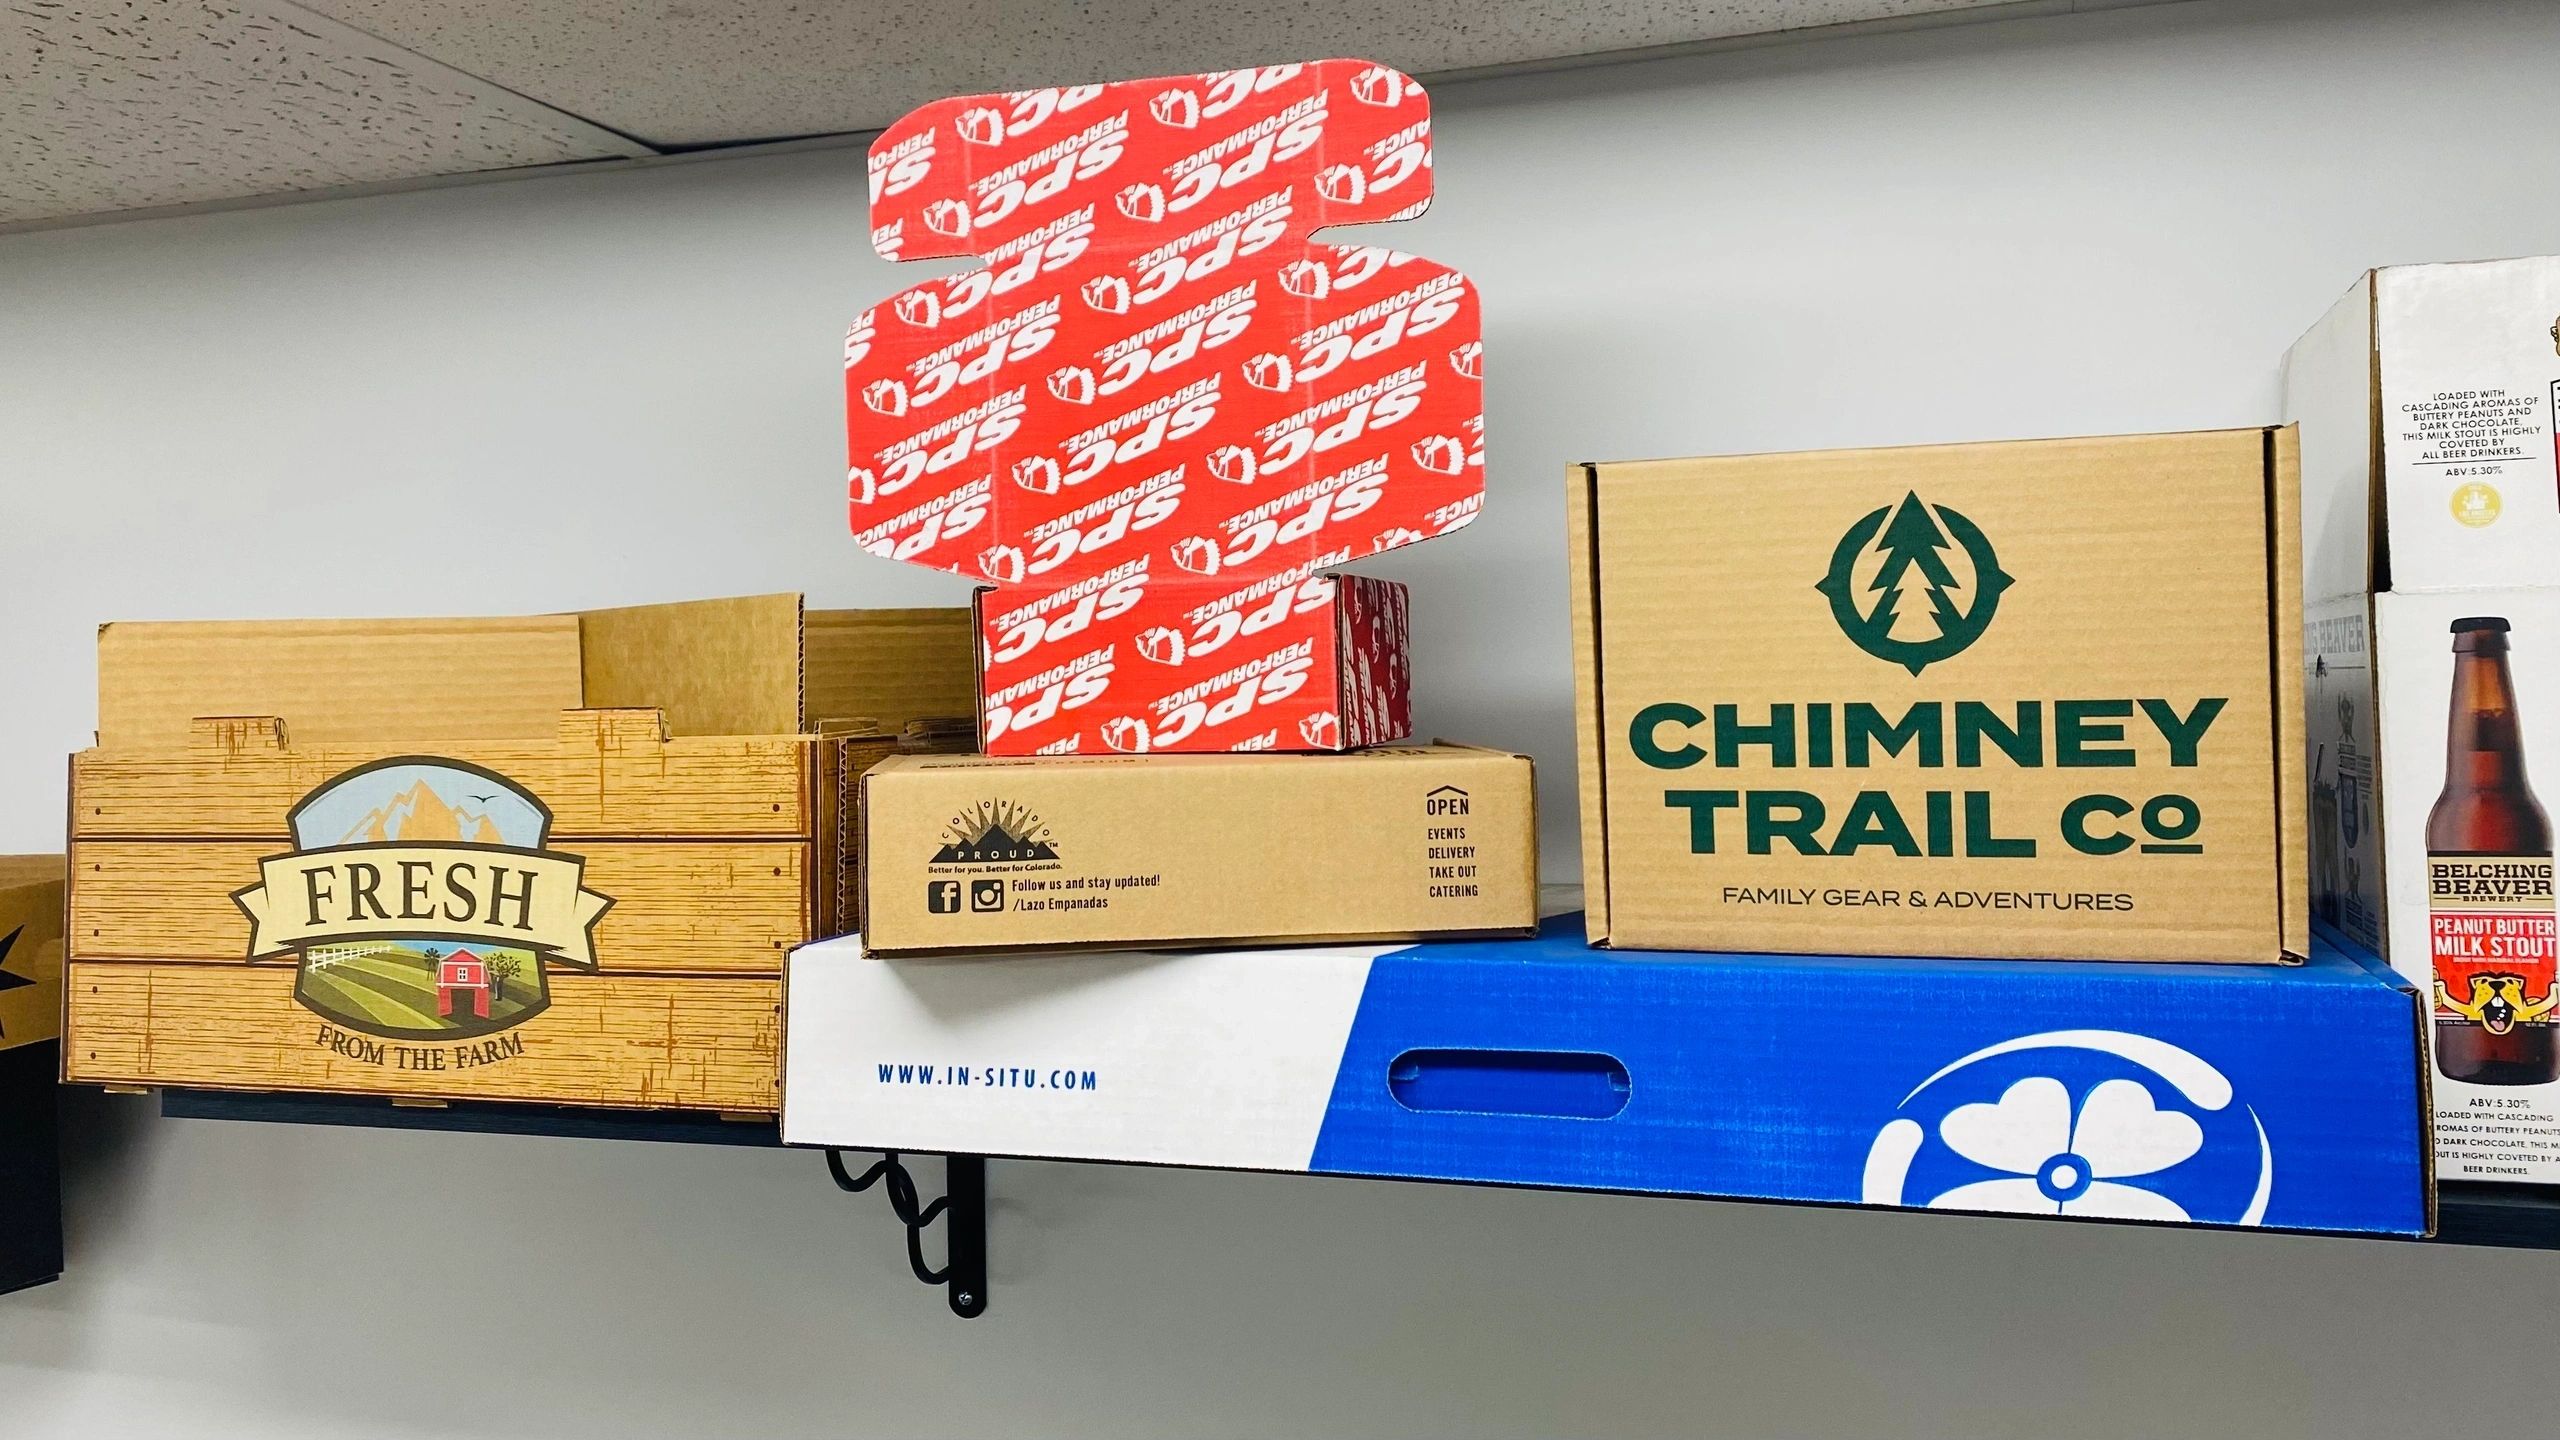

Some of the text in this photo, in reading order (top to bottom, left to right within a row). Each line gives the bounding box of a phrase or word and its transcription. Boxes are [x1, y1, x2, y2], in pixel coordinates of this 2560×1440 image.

[975, 110, 1129, 196] PERFORMANCE
[1168, 110, 1329, 212] SPC
[1171, 89, 1329, 180] PERFORMANCE
[974, 129, 1130, 228] SPC
[1133, 206, 1293, 304] SPC
[1136, 185, 1293, 273] PERFORMANCE
[942, 223, 1095, 319] SPC
[913, 295, 1060, 376] PERFORMANCE
[1102, 279, 1257, 362] PERFORMANCE
[1295, 286, 1465, 382] SPC
[1299, 272, 1464, 350] PERFORMANCE
[910, 314, 1060, 407] SPC
[1098, 300, 1257, 395] SPC
[880, 384, 1026, 464] PERFORMANCE
[1067, 372, 1221, 453] PERFORMANCE
[1259, 381, 1427, 475] SPC
[1263, 360, 1426, 443] PERFORMANCE
[2402, 397, 2539, 412] CASCADING AROMAS OF
[2413, 407, 2532, 421] BUTTERY PEANUTS AND
[2420, 421, 2449, 431] DARK
[2433, 389, 2505, 401] LOADED WITH
[878, 404, 1026, 495] SPC
[1063, 392, 1221, 485] SPC
[2402, 426, 2541, 441] THIS MILK STOUT IS HIGHLY
[2422, 451, 2439, 460] ALL
[2442, 449, 2467, 459] BEER
[2439, 438, 2505, 449] COVETED BY
[1028, 483, 1185, 574] SPC
[1032, 464, 1185, 543] PERFORMANCE
[1223, 473, 1388, 567] SPC
[1227, 453, 1388, 544] PERFORMANCE
[994, 573, 1149, 663] SPC
[997, 554, 1149, 632] PERFORMANCE
[1188, 576, 1336, 657] SPC
[1153, 657, 1313, 747] SPC
[1157, 637, 1313, 715] PERFORMANCE
[1628, 697, 2229, 770] CHIMNEY
[942, 801, 1050, 839] COLORADO
[1426, 799, 1469, 816] OPEN
[1428, 828, 1466, 839] EVENTS
[1664, 790, 2037, 858] TRAIL
[928, 862, 1063, 876] Better for you. Better for Colorado.
[957, 849, 1034, 860] PROUD
[1012, 874, 1160, 892] Follow us and stay updated!
[1429, 847, 1476, 859] DELIVERY
[1429, 866, 1477, 878] TAKE OUT
[2432, 864, 2552, 879] BELCHING
[2432, 880, 2553, 895] BEAVER
[300, 861, 539, 931] FRESH
[1012, 896, 1108, 912] /Lazo Empanadas
[1430, 885, 1478, 897] CATERING
[1722, 887, 2134, 911] FAMILY GEAR & ADVENTURES
[2434, 918, 2556, 936] PEANUT BUTTER
[2434, 936, 2556, 957] MILK STOUT
[315, 1023, 525, 1071] FROM THE FARM
[878, 1063, 1097, 1090] WWW.IN-SITU.COM
[2436, 1111, 2554, 1122] LOADED WITH CASCADING
[2436, 1124, 2468, 1133] ROMAS
[2471, 1125, 2483, 1133] OF
[2486, 1126, 2520, 1134] BUTTERY
[2443, 1138, 2467, 1146] DARK
[2530, 1141, 2548, 1149] THIS
[2452, 1151, 2460, 1159] IS
[2462, 1152, 2493, 1160] HIGHLY
[2497, 1153, 2538, 1162] COVETED
[2463, 1165, 2483, 1173] BEER
